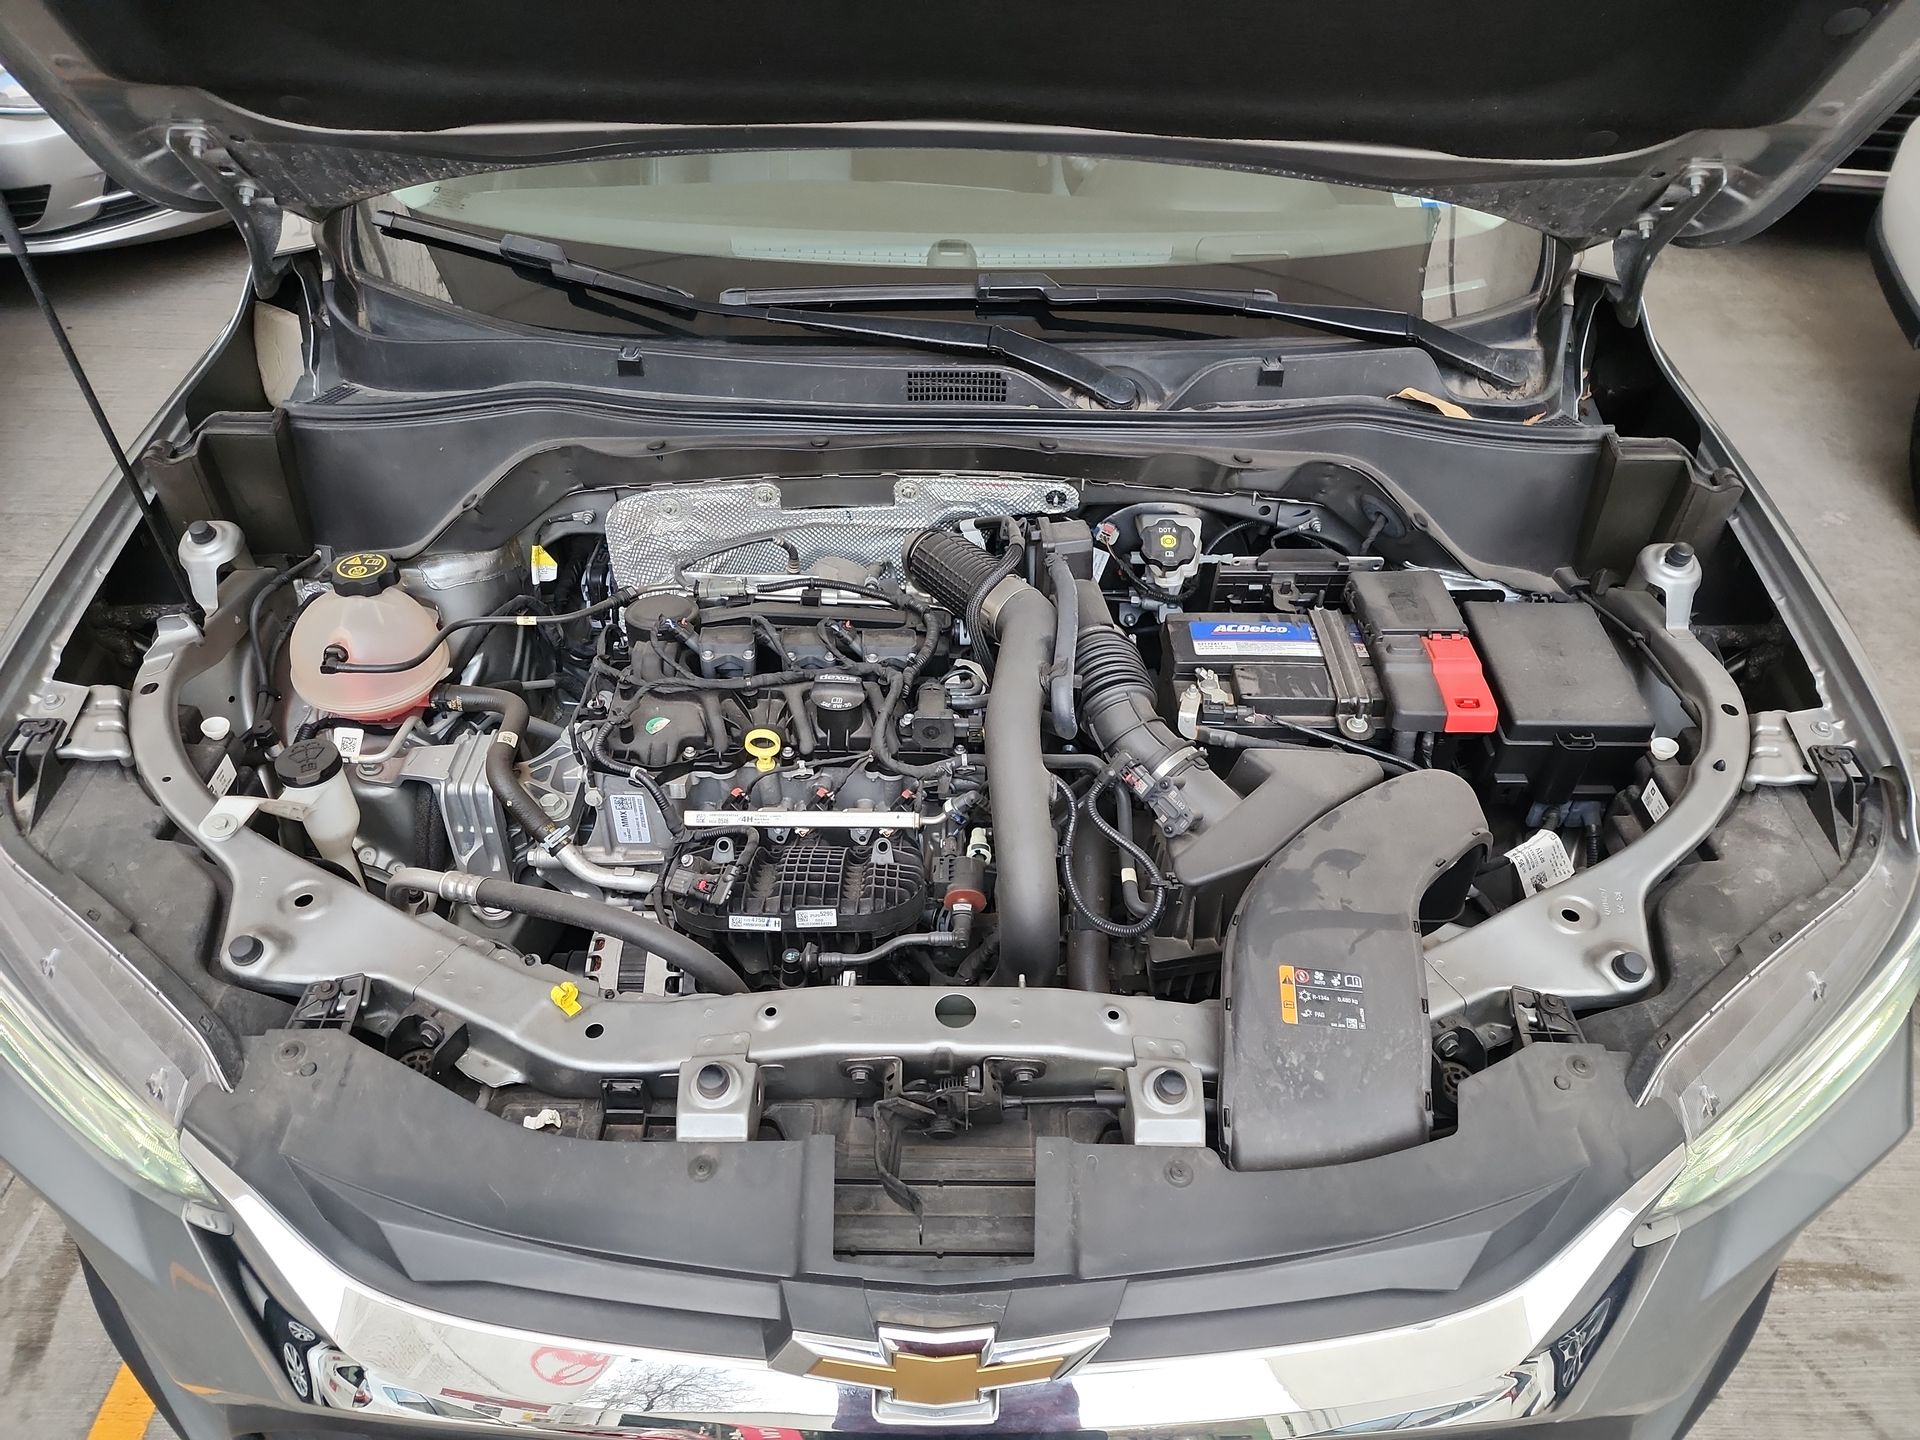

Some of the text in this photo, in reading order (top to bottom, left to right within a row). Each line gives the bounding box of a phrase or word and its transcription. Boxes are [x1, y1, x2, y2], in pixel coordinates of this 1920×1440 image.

[1212, 624, 1288, 634] ACDelco
[819, 673, 857, 682] dexos
[620, 810, 629, 828] MMX
[774, 920, 780, 928] H
